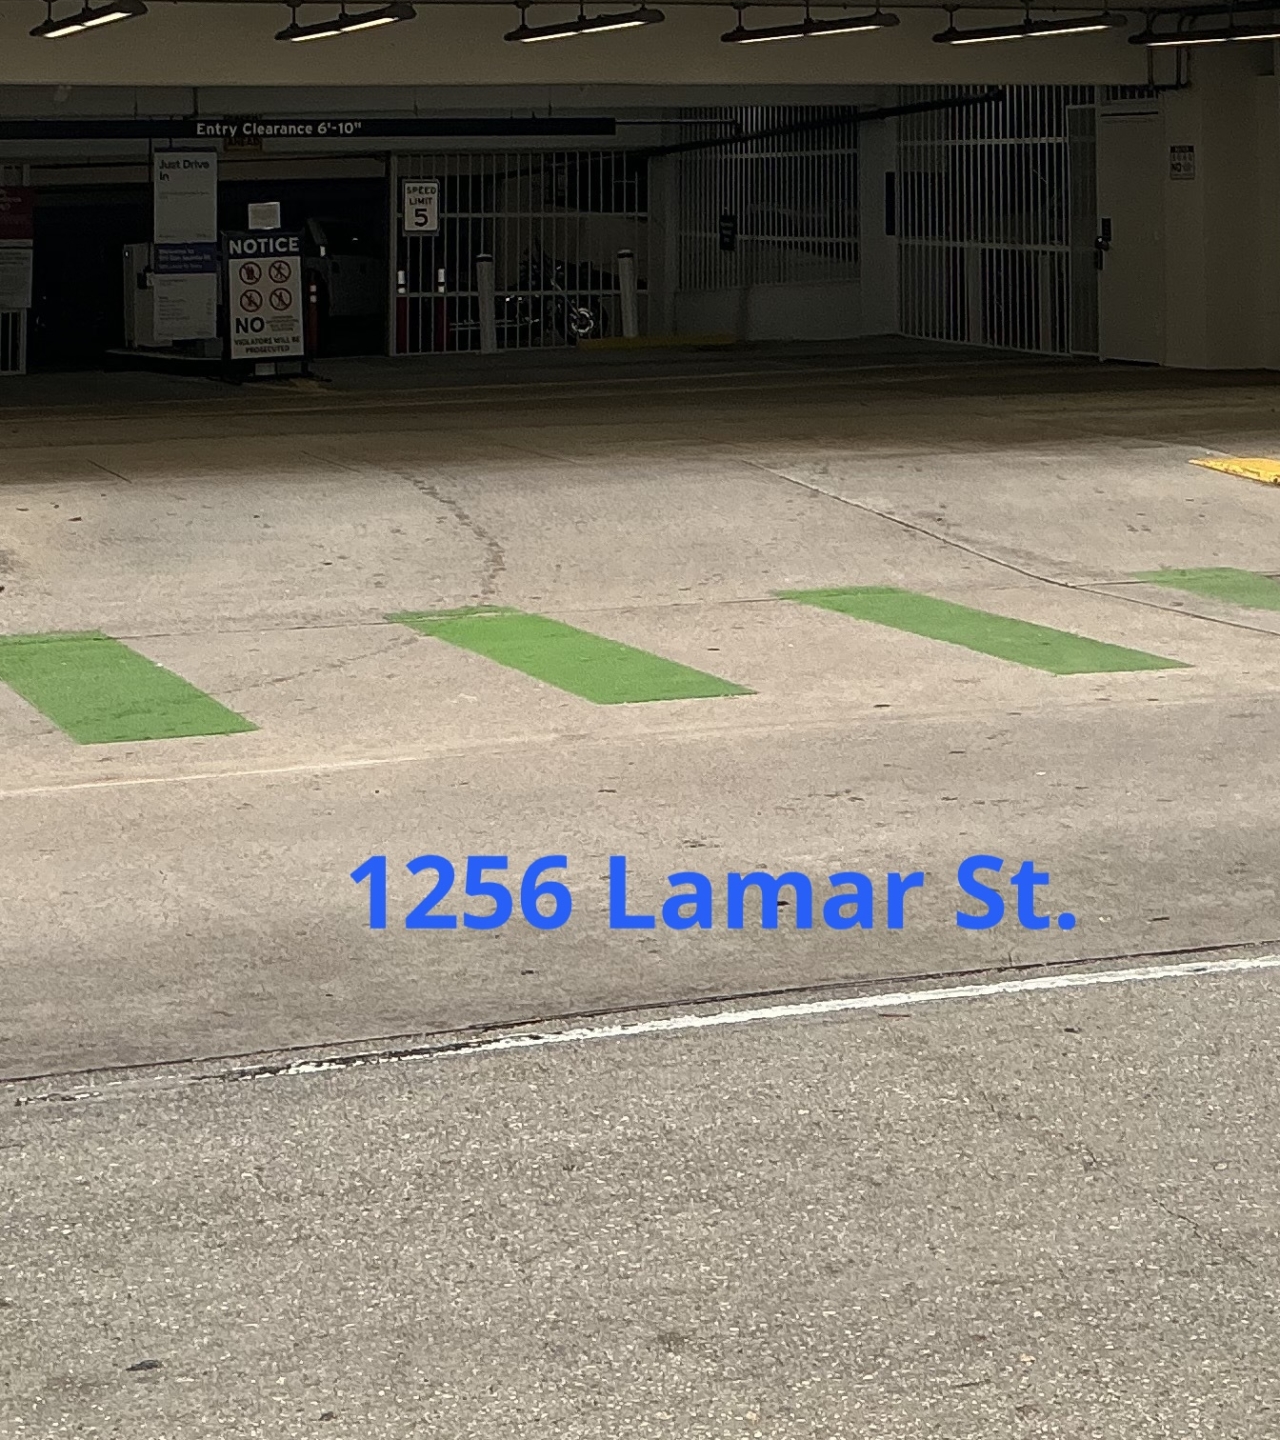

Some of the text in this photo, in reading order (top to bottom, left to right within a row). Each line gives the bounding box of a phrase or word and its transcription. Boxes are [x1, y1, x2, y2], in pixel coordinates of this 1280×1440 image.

[196, 121, 363, 138] Entry Clearance 6'-10"
[159, 159, 210, 170] Just Drive
[159, 171, 170, 182] In
[407, 186, 437, 195] SPEED
[409, 197, 433, 206] LIMIT
[414, 208, 429, 227] 5
[229, 237, 300, 255] NOTICE
[235, 317, 265, 333] NO
[234, 337, 273, 346] VIOLATORS
[245, 345, 290, 354] PROSECUTED
